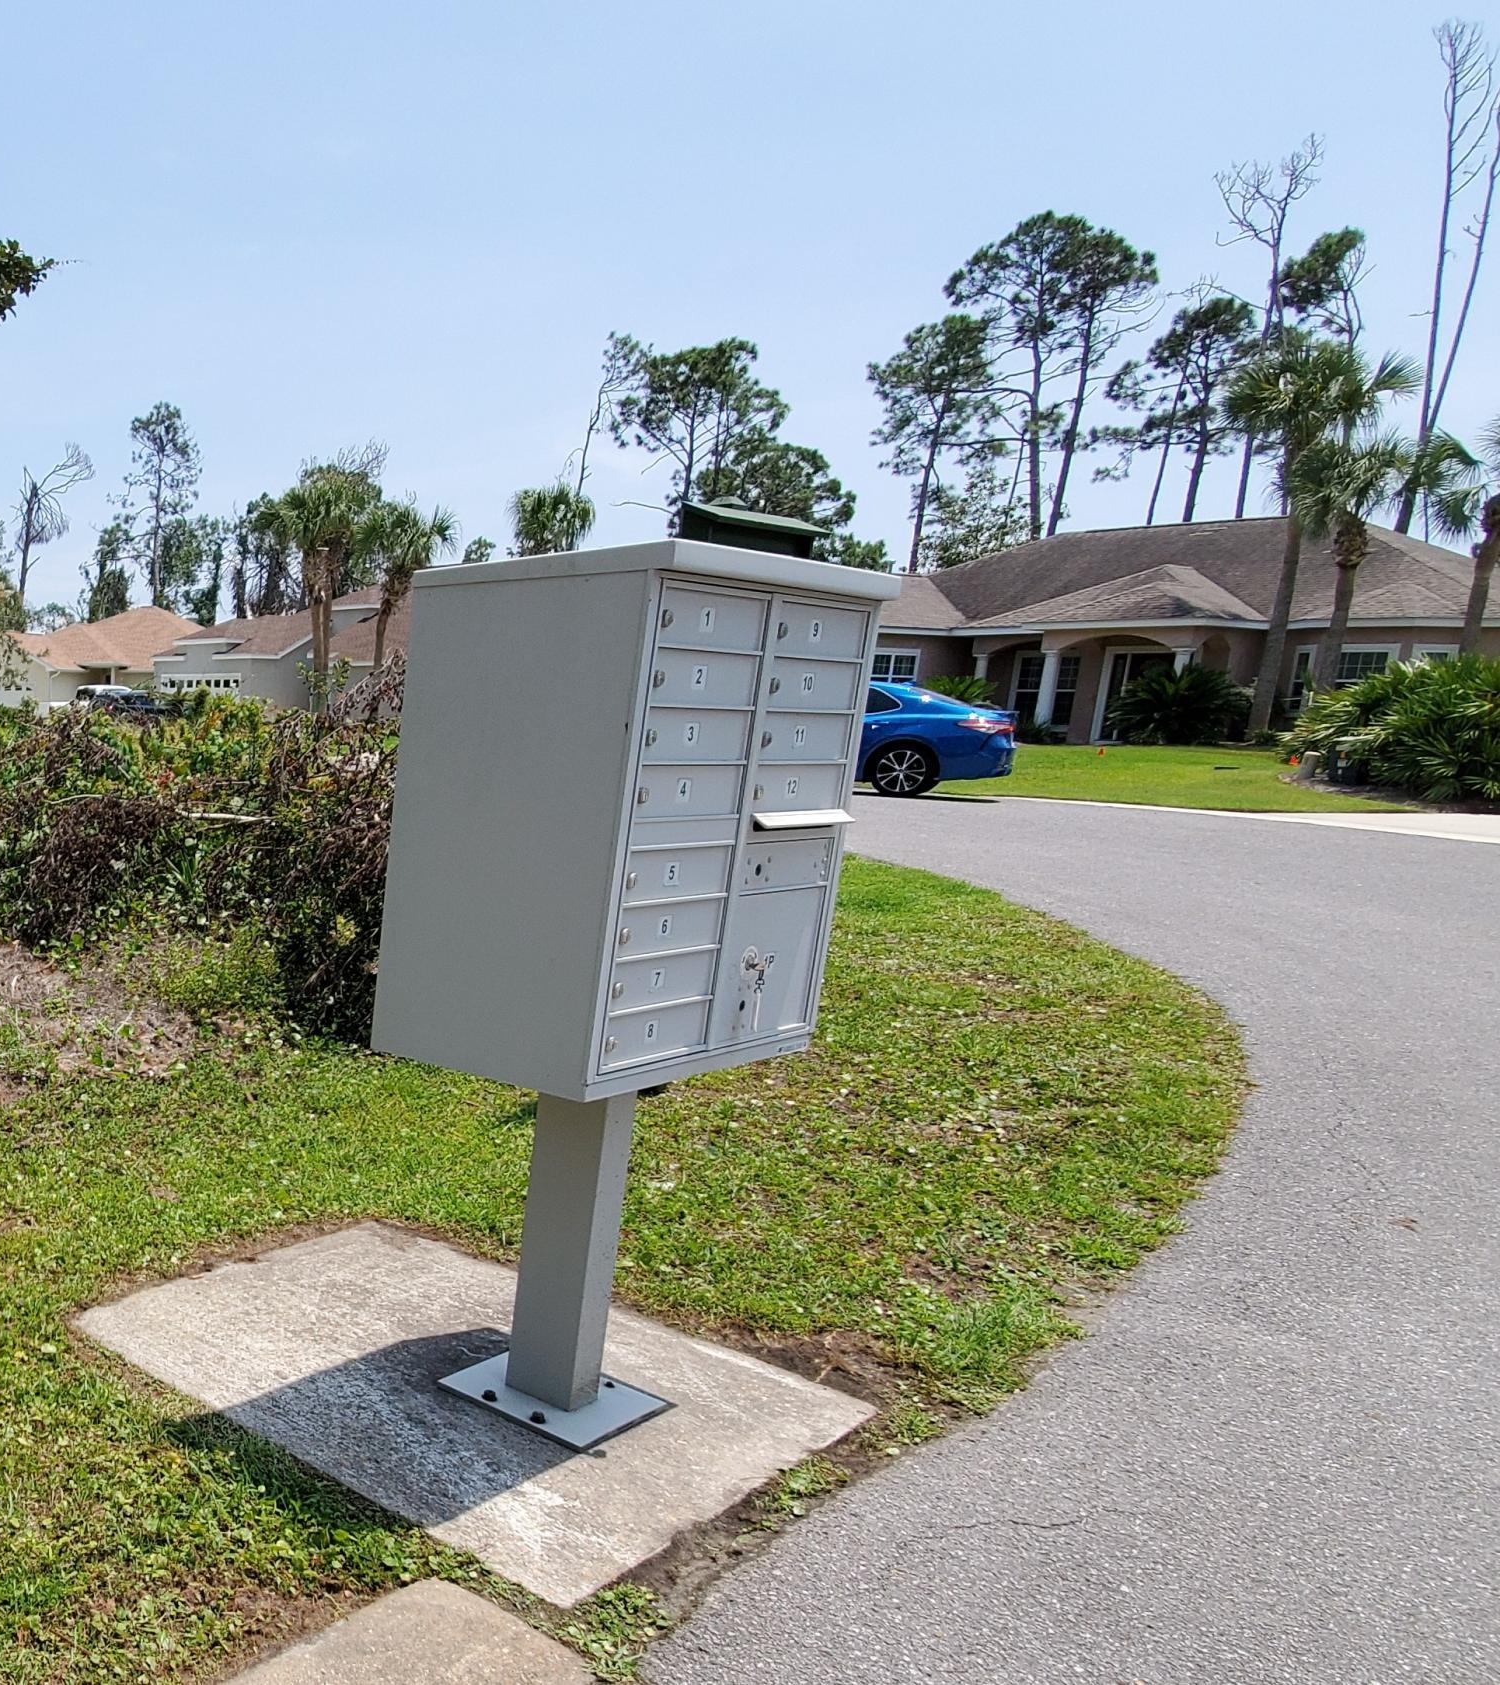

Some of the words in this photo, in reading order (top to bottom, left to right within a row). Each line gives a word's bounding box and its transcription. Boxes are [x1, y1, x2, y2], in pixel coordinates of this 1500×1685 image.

[704, 611, 711, 627] 1
[812, 622, 819, 638] 9
[695, 668, 703, 685] 2
[803, 675, 813, 691] 10
[687, 725, 695, 742] 3
[795, 728, 805, 743] 11
[679, 780, 687, 797] 4
[787, 779, 797, 795] 12
[668, 865, 676, 881] 5
[661, 919, 669, 934] 6
[654, 971, 662, 987] 7
[647, 1023, 655, 1039] 8
